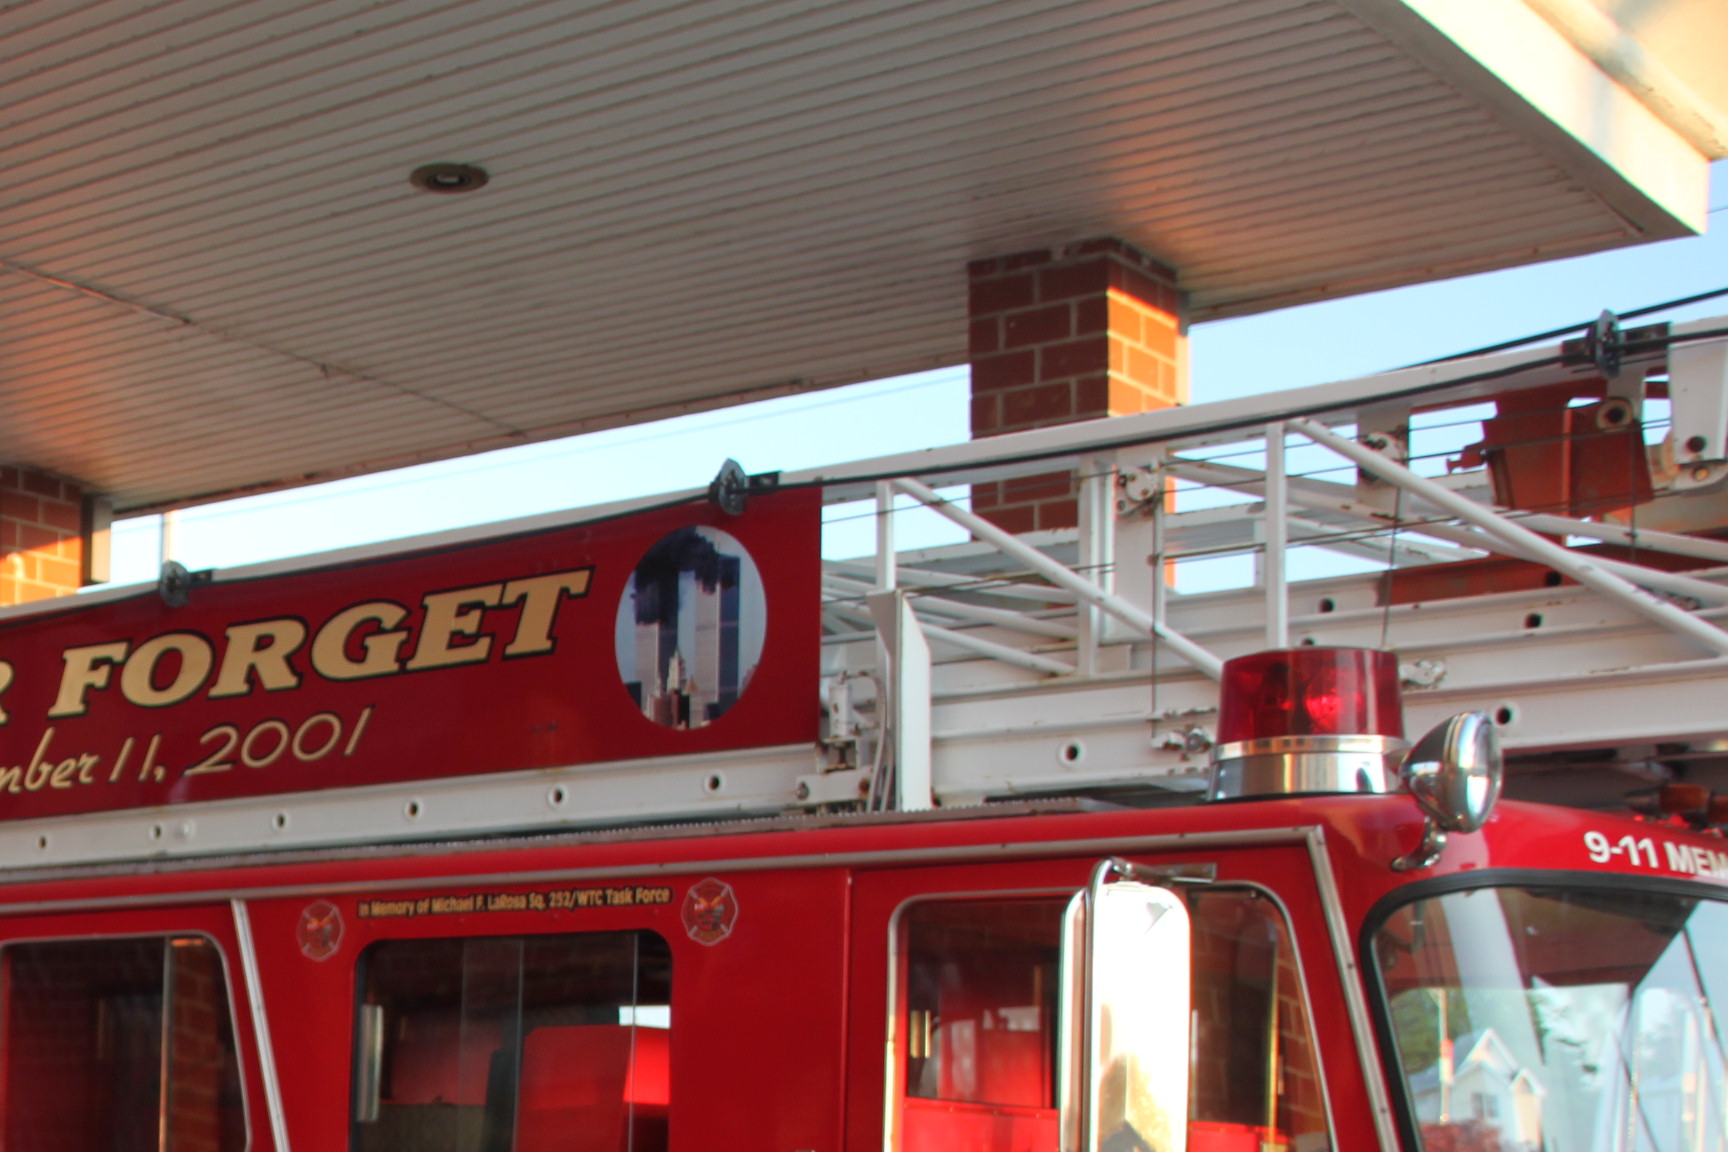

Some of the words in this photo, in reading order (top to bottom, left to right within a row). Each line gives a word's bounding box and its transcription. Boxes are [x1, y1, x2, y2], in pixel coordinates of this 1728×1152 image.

[48, 566, 594, 718] FORGET
[184, 705, 375, 777] 2001
[1584, 830, 1659, 868] 9-11
[371, 898, 415, 918] Memory
[635, 886, 671, 904] Force
